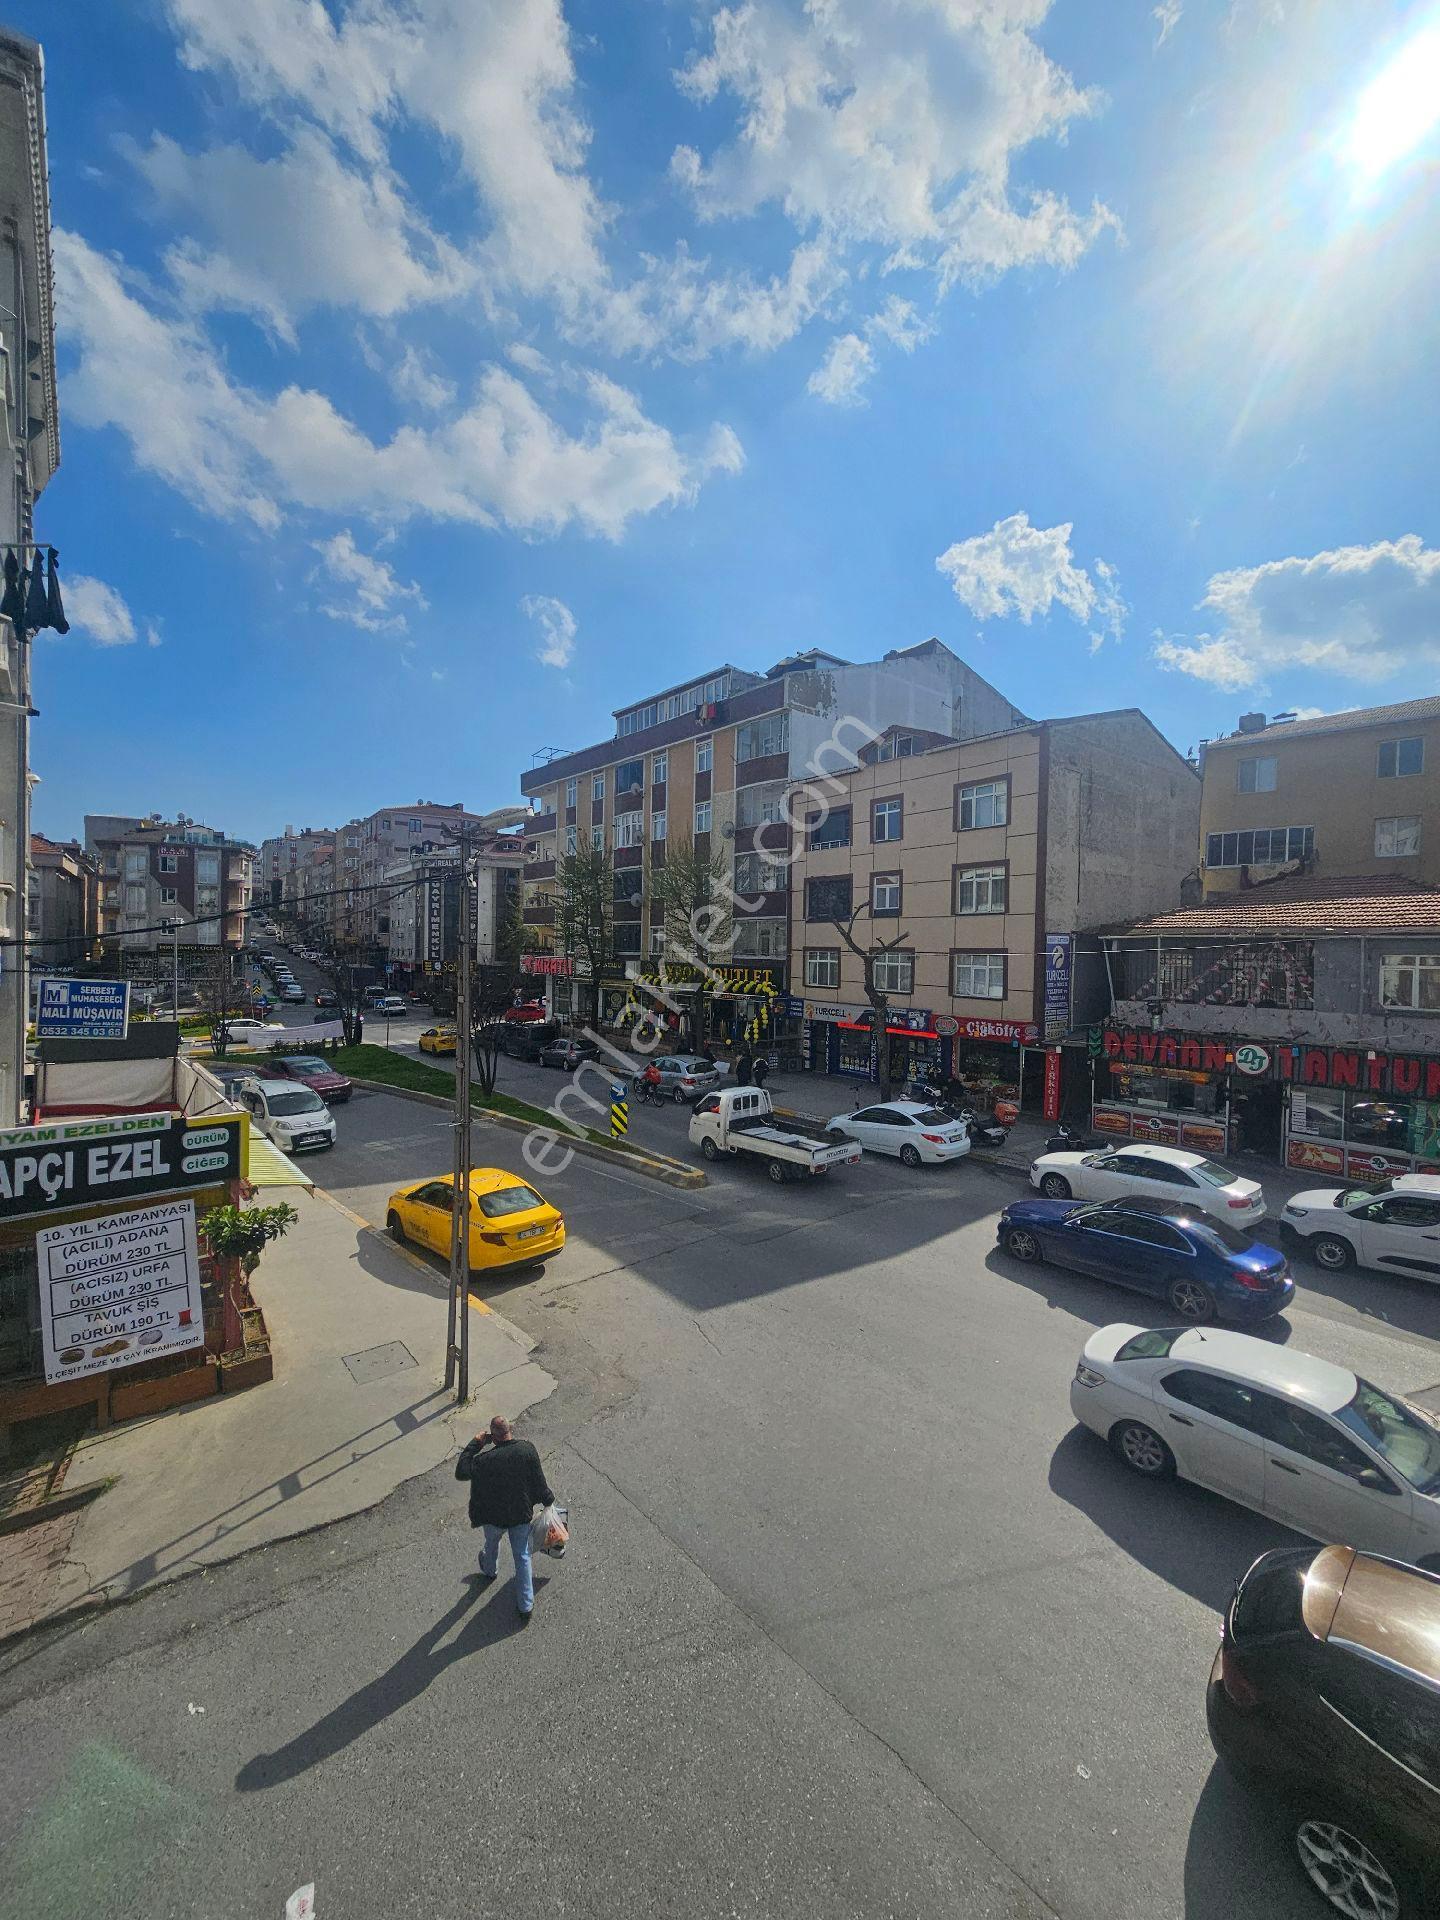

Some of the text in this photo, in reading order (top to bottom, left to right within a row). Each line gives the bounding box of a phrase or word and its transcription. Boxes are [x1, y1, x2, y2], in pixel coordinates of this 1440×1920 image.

[713, 967, 773, 983] OUTLET
[80, 986, 116, 995] SERBEST
[41, 1006, 123, 1022] MALİ MÜŞAVİR
[815, 1007, 847, 1018] TURKCELL
[41, 1027, 67, 1035] 0532
[71, 1028, 89, 1036] 345
[93, 1028, 105, 1036] 03
[966, 1020, 1021, 1038] Çiğköfte
[1103, 1030, 1226, 1071] DEVRAN
[0, 1117, 166, 1145] YAM EZELDEN
[186, 1132, 227, 1147] DÜRÜM
[88, 1139, 170, 1186] EZEL
[186, 1155, 225, 1170] CİĞER
[43, 1204, 191, 1243] 10. YIL KAMPANYASI
[63, 1225, 169, 1259] (ACILI) ADANA
[65, 1241, 171, 1274] DÜRÜM 230 TL
[70, 1261, 170, 1294] (ACISIZ) URFA
[69, 1276, 173, 1309] DÜRÜM 230 TL
[84, 1297, 160, 1323] TAVUK ŞİŞ
[71, 1310, 174, 1344] DÜRÜM 190 TL
[83, 1359, 107, 1370] MEZE
[109, 1356, 121, 1365] VE
[123, 1351, 141, 1362] ÇAY
